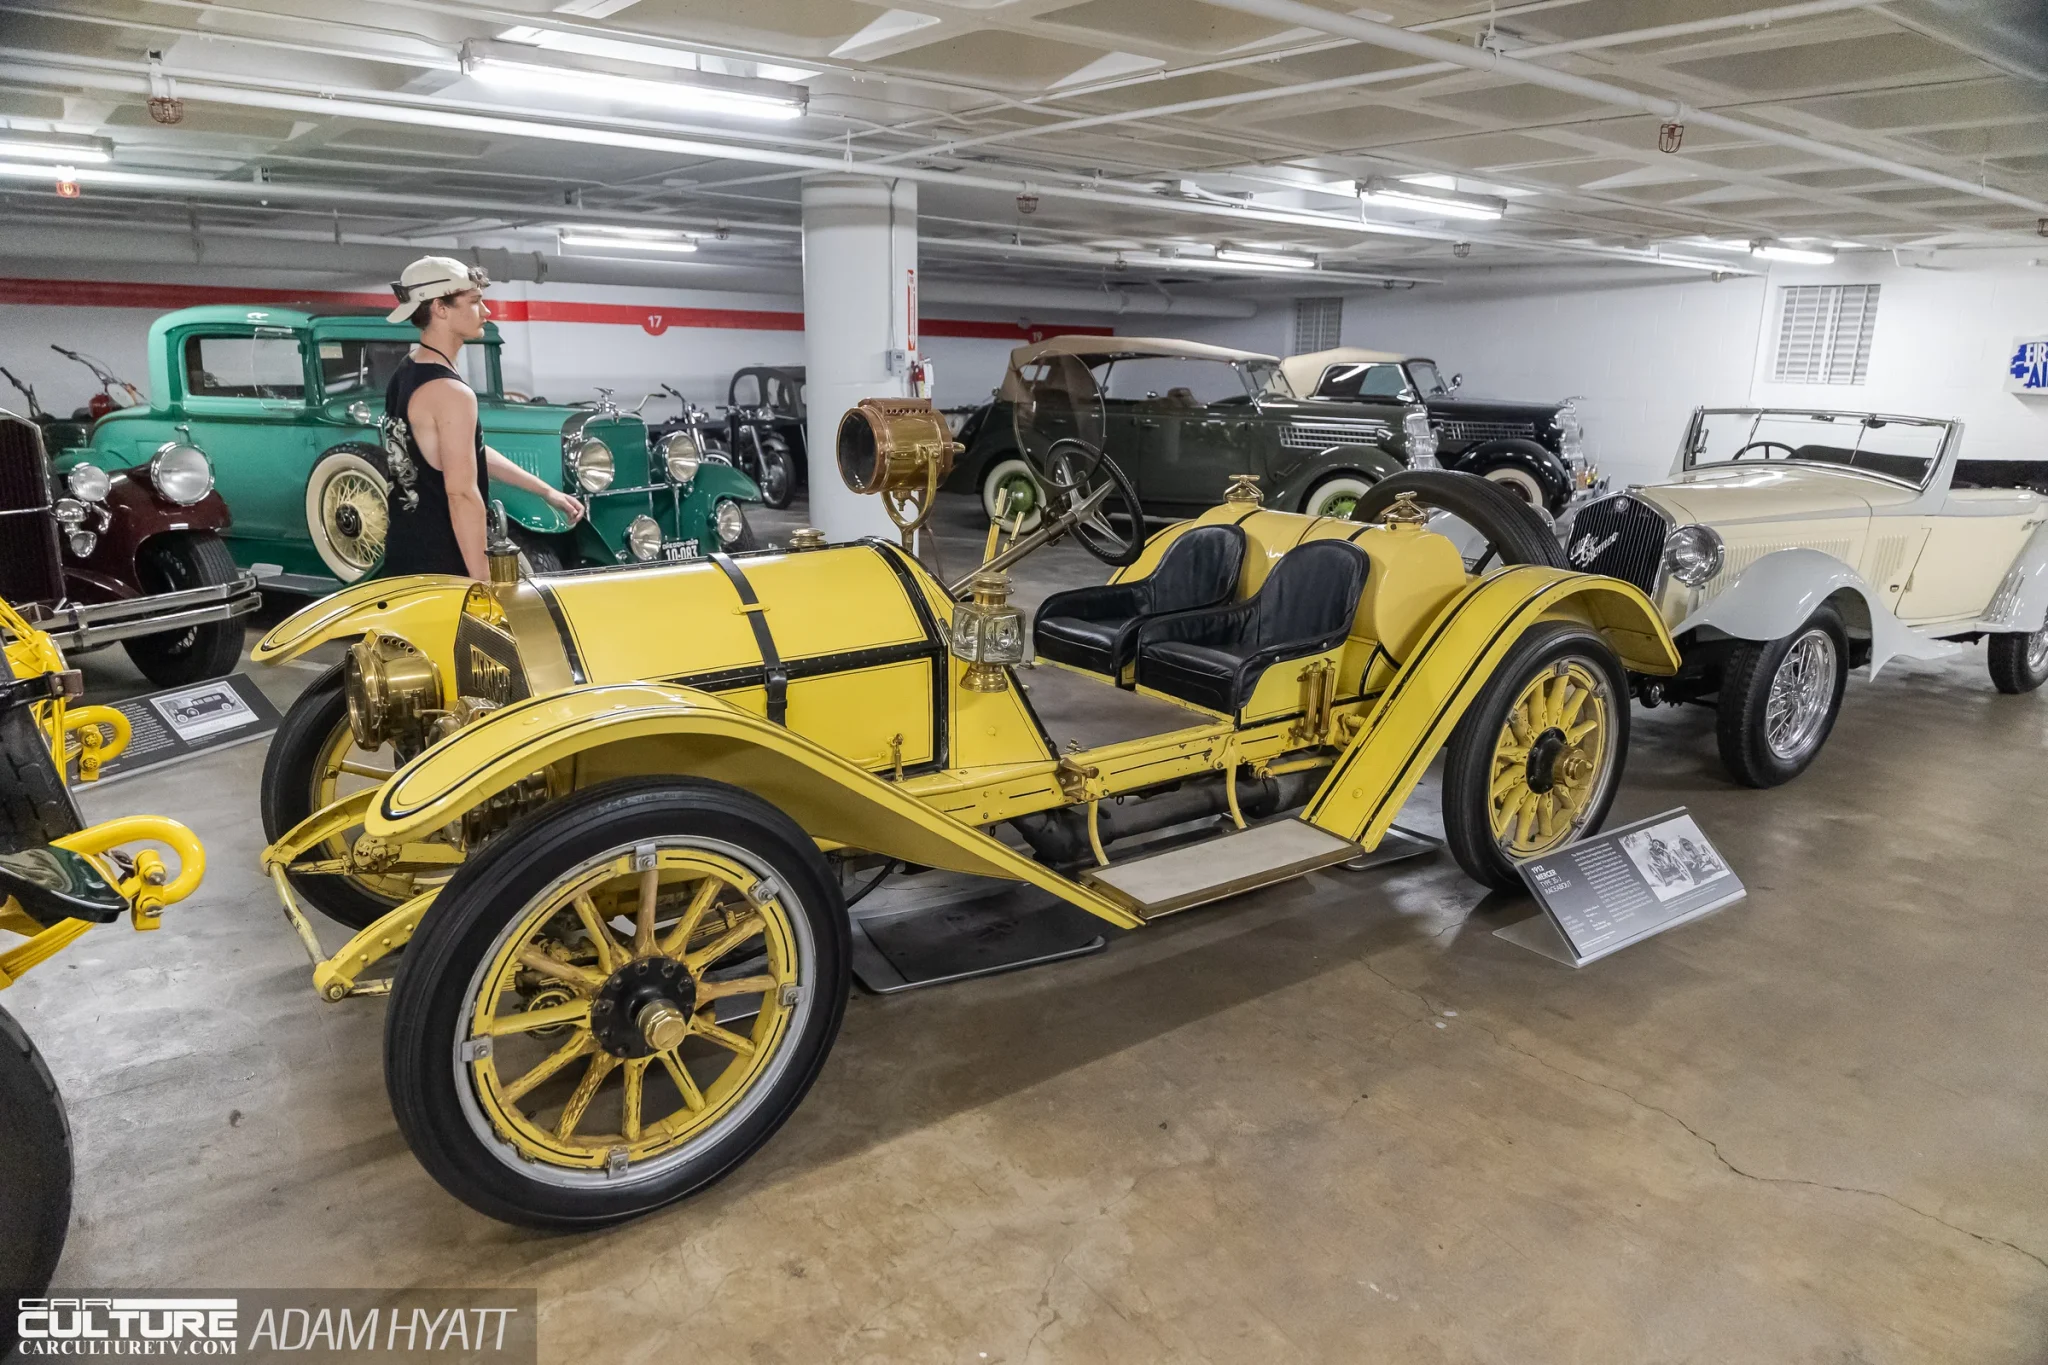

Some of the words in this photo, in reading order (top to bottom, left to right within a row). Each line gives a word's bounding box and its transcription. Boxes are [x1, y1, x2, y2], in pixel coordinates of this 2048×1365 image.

[648, 315, 662, 328] 17
[2025, 342, 2048, 362] FIR
[2023, 362, 2048, 388] AI
[1531, 865, 1545, 874] 1913
[1535, 869, 1558, 881] MERCER
[1544, 880, 1573, 895] RACEABOUT
